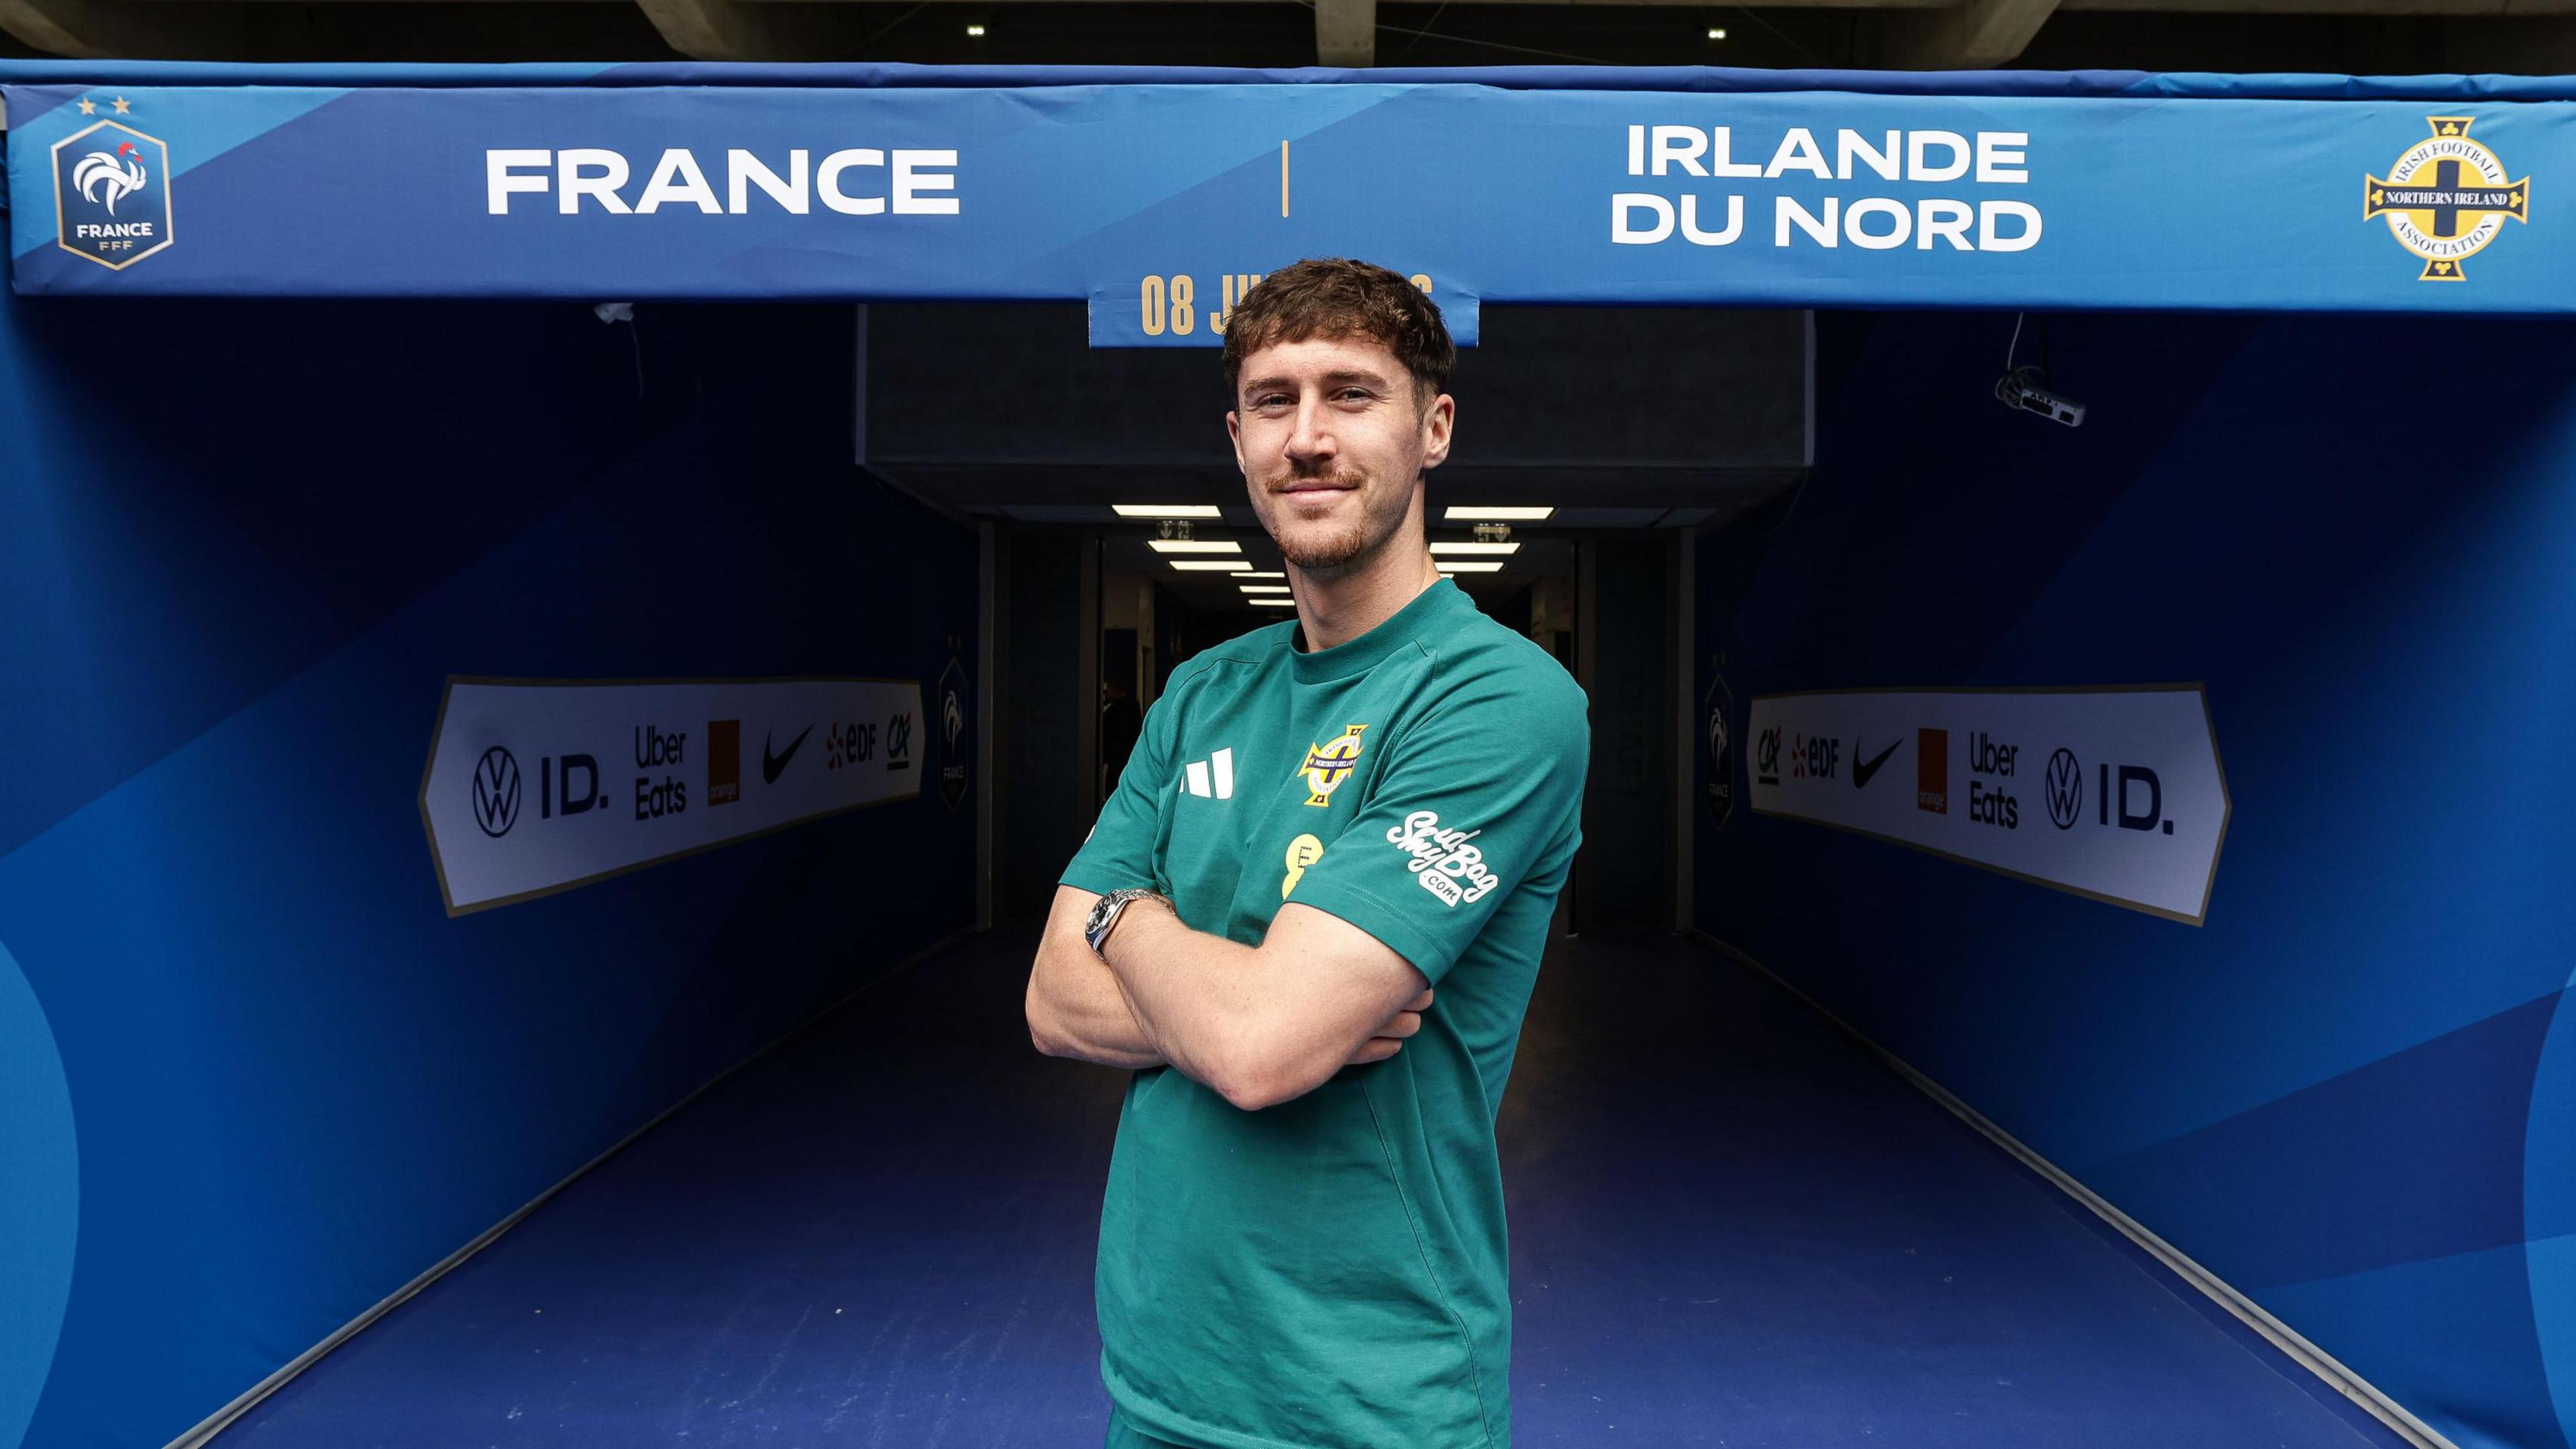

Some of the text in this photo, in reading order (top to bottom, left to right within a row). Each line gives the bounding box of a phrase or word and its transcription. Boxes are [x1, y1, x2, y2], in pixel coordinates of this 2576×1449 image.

[1628, 125, 2029, 183] IRLANDE
[2396, 141, 2498, 184] IRISH FOOTBALL
[486, 148, 960, 215] FRANCE
[2385, 191, 2508, 206] NORTHERN IRELAND
[76, 222, 154, 238] FRANCE
[99, 240, 133, 251] FFF
[1611, 193, 2043, 253] DU NORD
[2396, 221, 2495, 255] ASSOCIATION
[1141, 274, 1195, 335] 08
[636, 725, 686, 768] Uber
[1970, 732, 2018, 776] Uber
[541, 754, 608, 820] ID.
[636, 775, 686, 821] Eats
[1970, 781, 2018, 829] Eats
[2100, 763, 2174, 835] ID.
[1435, 844, 1499, 903] Bag
